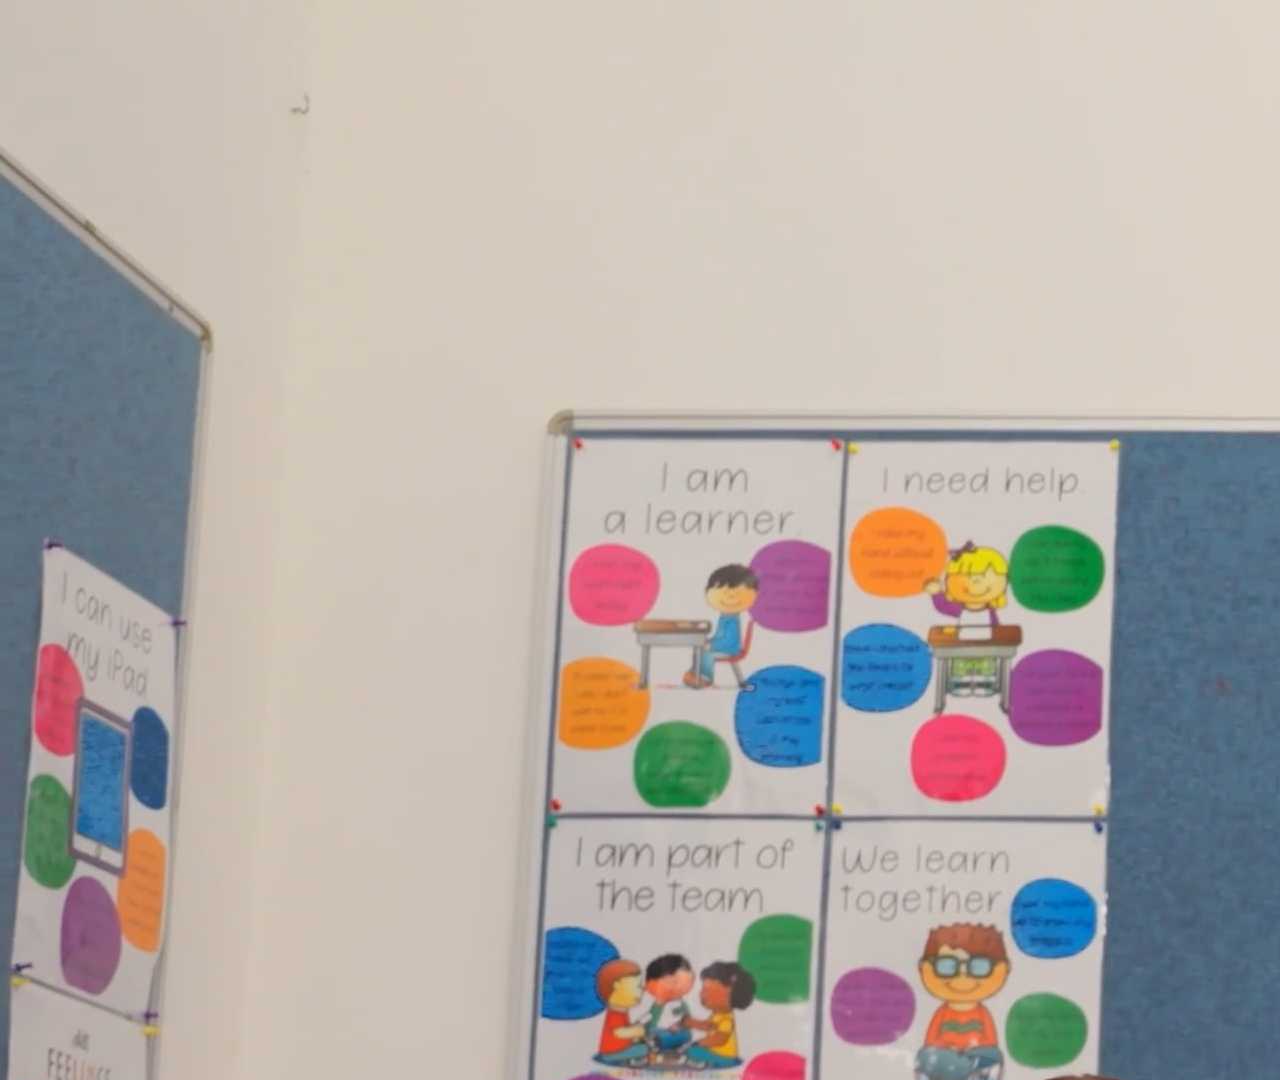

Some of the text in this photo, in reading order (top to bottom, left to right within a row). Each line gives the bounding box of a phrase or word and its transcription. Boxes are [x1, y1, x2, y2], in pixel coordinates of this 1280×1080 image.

[661, 461, 749, 494] I am
[881, 467, 1079, 502] I need help
[603, 503, 795, 535] a learner
[75, 587, 112, 630] can
[120, 616, 152, 654] use
[67, 632, 148, 696] my iPad
[575, 837, 794, 875] I am part of
[841, 844, 1010, 874] We learn
[595, 880, 764, 913] the team
[841, 883, 1001, 922] together
